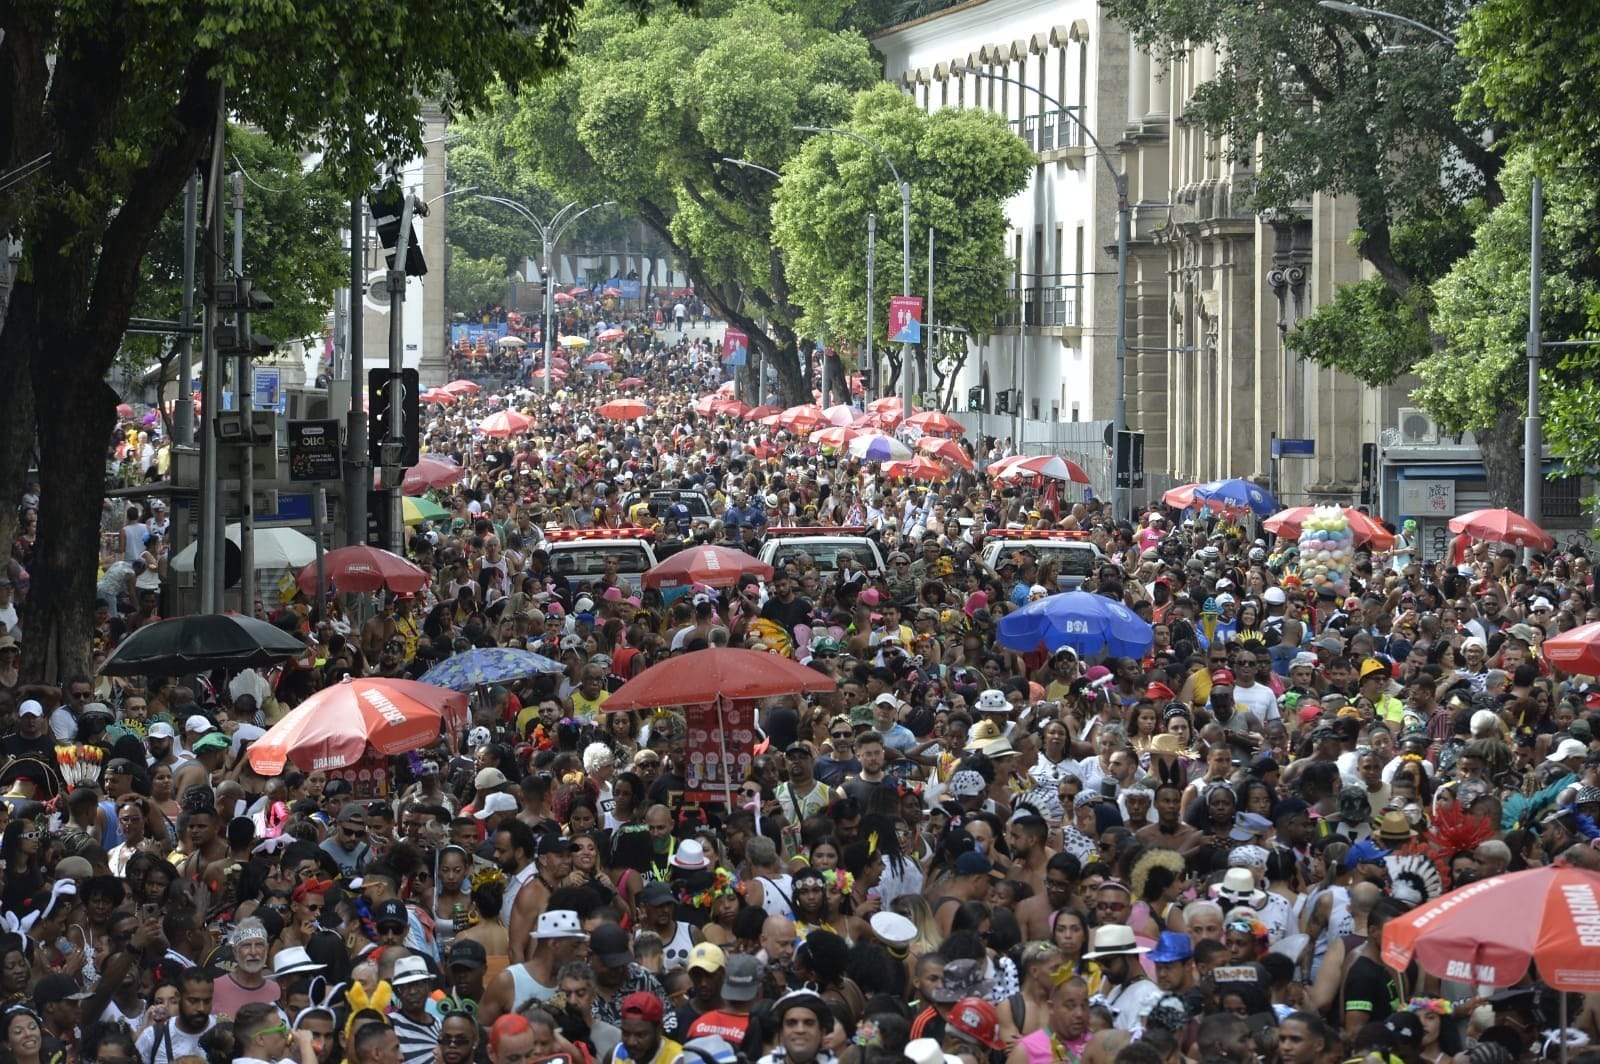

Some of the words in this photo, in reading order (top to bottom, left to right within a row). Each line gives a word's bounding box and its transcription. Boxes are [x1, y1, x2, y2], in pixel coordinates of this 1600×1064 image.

[1067, 620, 1089, 633] BOA
[360, 688, 408, 727] BRAHMA
[1412, 877, 1505, 929] BRAHMA
[1561, 883, 1600, 947] BRAHMA
